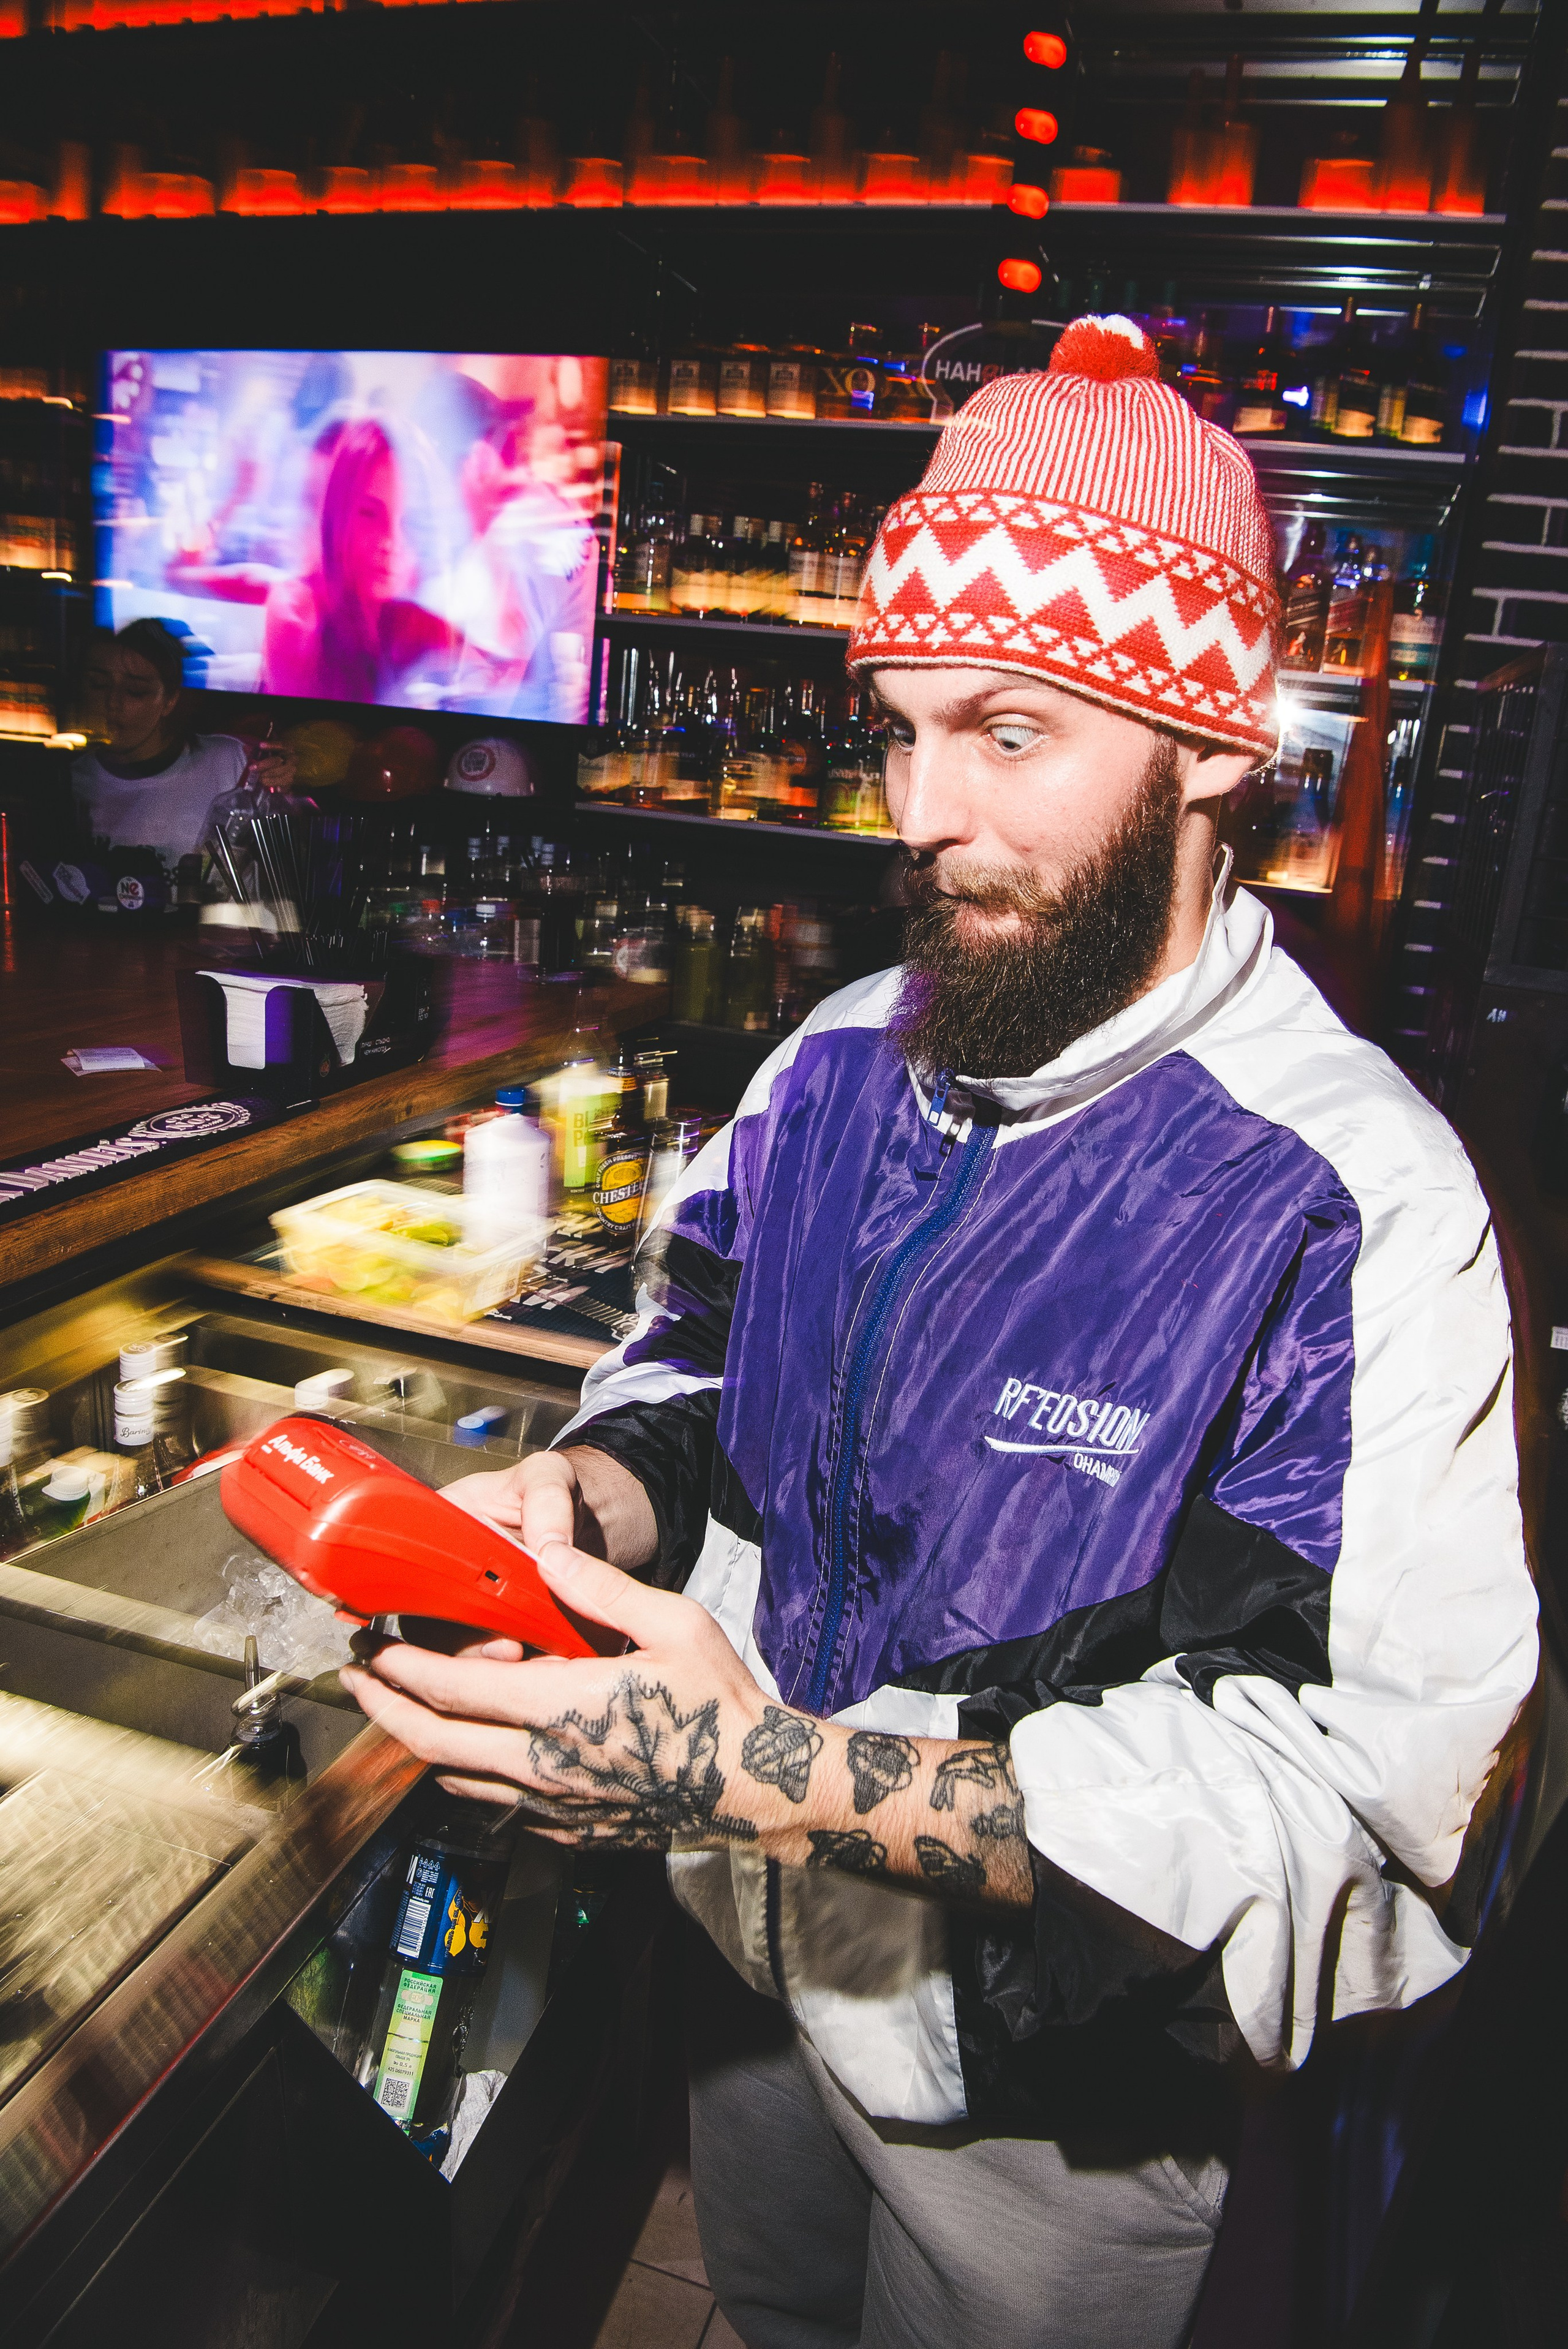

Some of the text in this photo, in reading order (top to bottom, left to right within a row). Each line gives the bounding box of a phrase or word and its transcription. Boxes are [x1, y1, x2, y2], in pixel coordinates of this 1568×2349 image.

[598, 1158, 612, 1173] FRESH
[268, 1434, 307, 1465] Альфа
[299, 1455, 335, 1485] Банк
[403, 1982, 436, 1994] ФЕДЕРАЦИЯ
[404, 1978, 437, 1989] РОССИЙСКАЯ
[396, 2008, 431, 2020] СПЕЦИАЛЬНАЯ
[398, 2004, 432, 2015] ФЕДЕРАЛЬНАЯ
